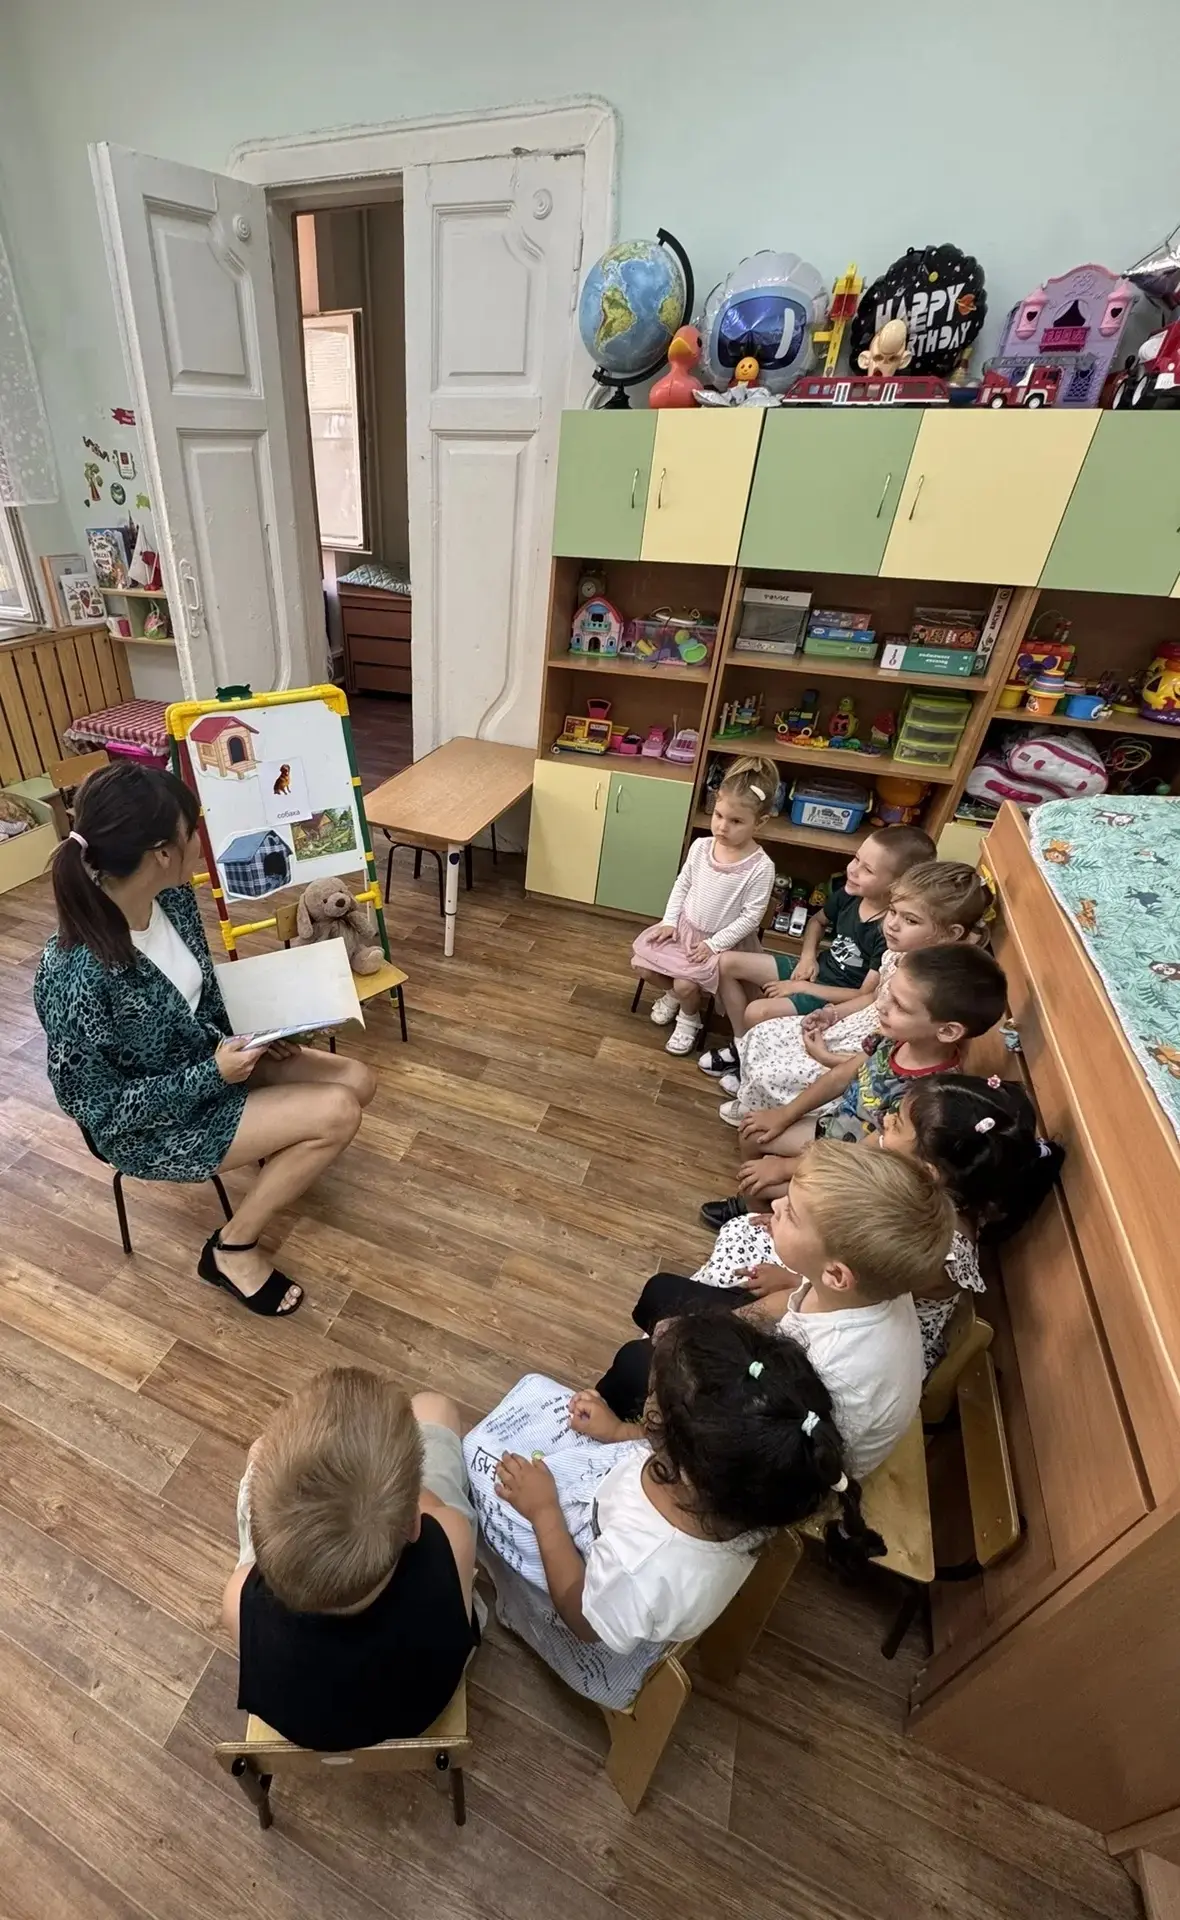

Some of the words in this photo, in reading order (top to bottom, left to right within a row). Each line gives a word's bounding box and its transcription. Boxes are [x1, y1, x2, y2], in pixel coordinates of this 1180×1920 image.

[875, 283, 965, 334] HAPPY
[907, 321, 971, 358] RTHDAY
[277, 809, 301, 820] собака
